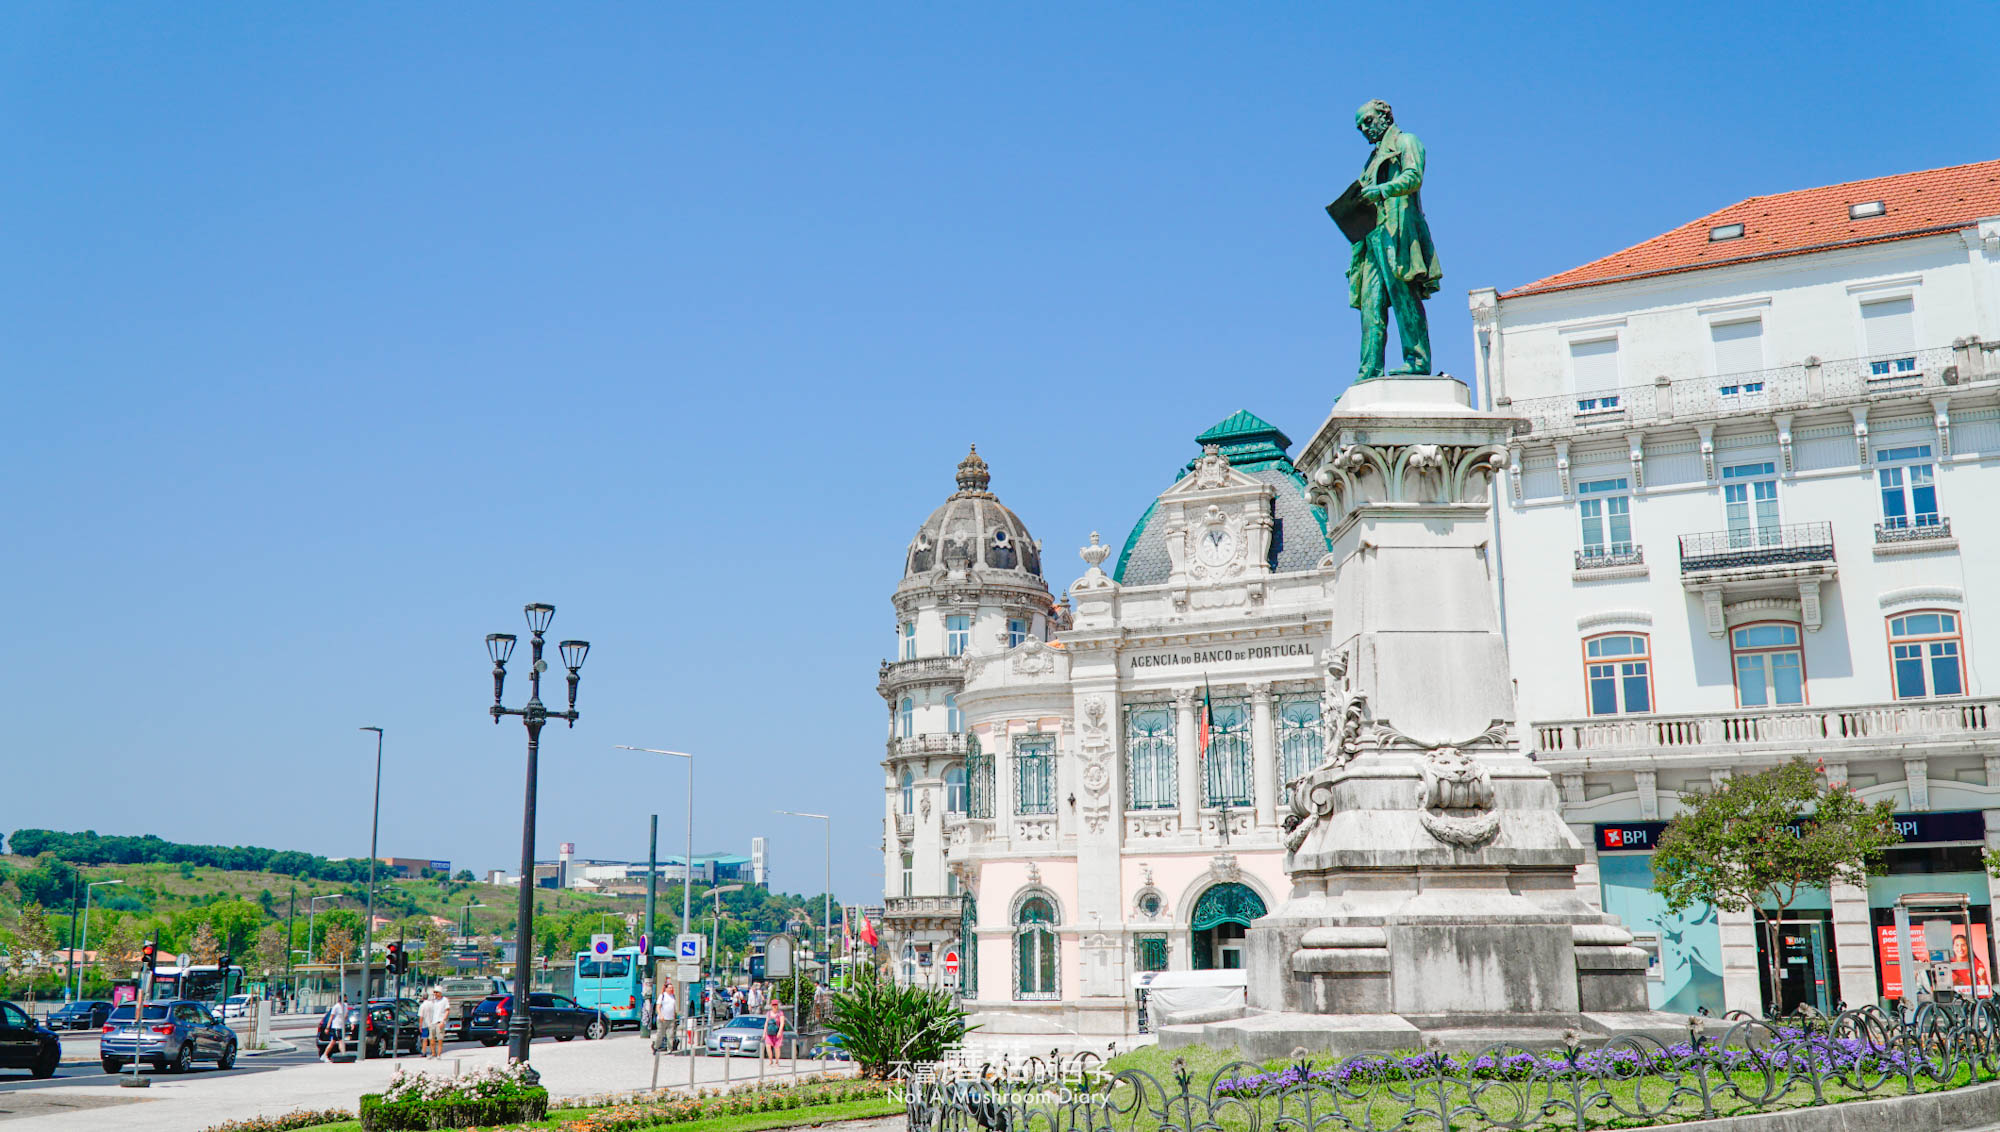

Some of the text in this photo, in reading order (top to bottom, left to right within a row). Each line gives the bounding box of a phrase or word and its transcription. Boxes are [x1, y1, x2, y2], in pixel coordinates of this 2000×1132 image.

[1131, 643, 1314, 668] AGENCIA DO BANCO DE PORTUGAL
[1893, 821, 1918, 836] BPI
[1623, 830, 1647, 844] BPI
